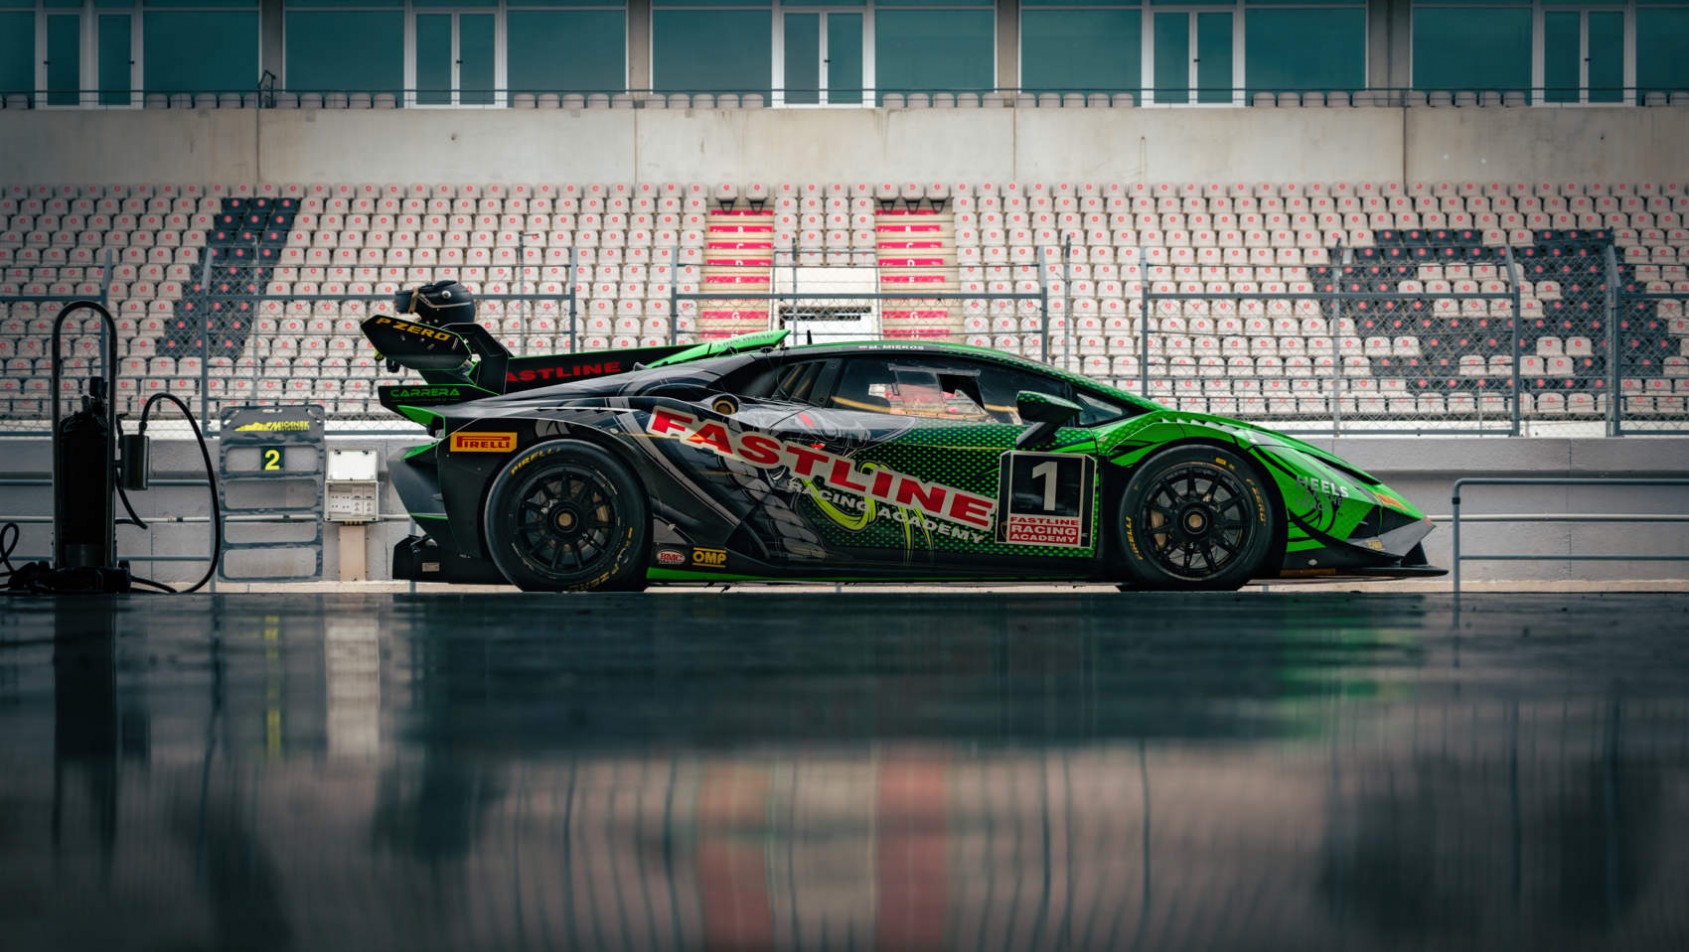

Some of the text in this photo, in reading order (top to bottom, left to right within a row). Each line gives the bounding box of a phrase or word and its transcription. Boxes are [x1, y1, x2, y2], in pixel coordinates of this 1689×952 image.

[375, 317, 452, 342] P ZERO
[506, 361, 622, 382] ASTLINE
[390, 388, 461, 397] CARRERA
[456, 436, 511, 448] PIRELLI
[265, 449, 280, 471] 2
[650, 409, 995, 528] FASTLINE
[1032, 461, 1058, 511] 1
[1296, 475, 1349, 498] HEELS
[788, 478, 986, 544] RACING ACADEMY
[1010, 516, 1079, 526] FASTLINE
[1011, 525, 1077, 536] RACING
[1011, 533, 1076, 543] ACADEMY
[1125, 516, 1144, 560] PIRELLI
[692, 551, 728, 565] OMP
